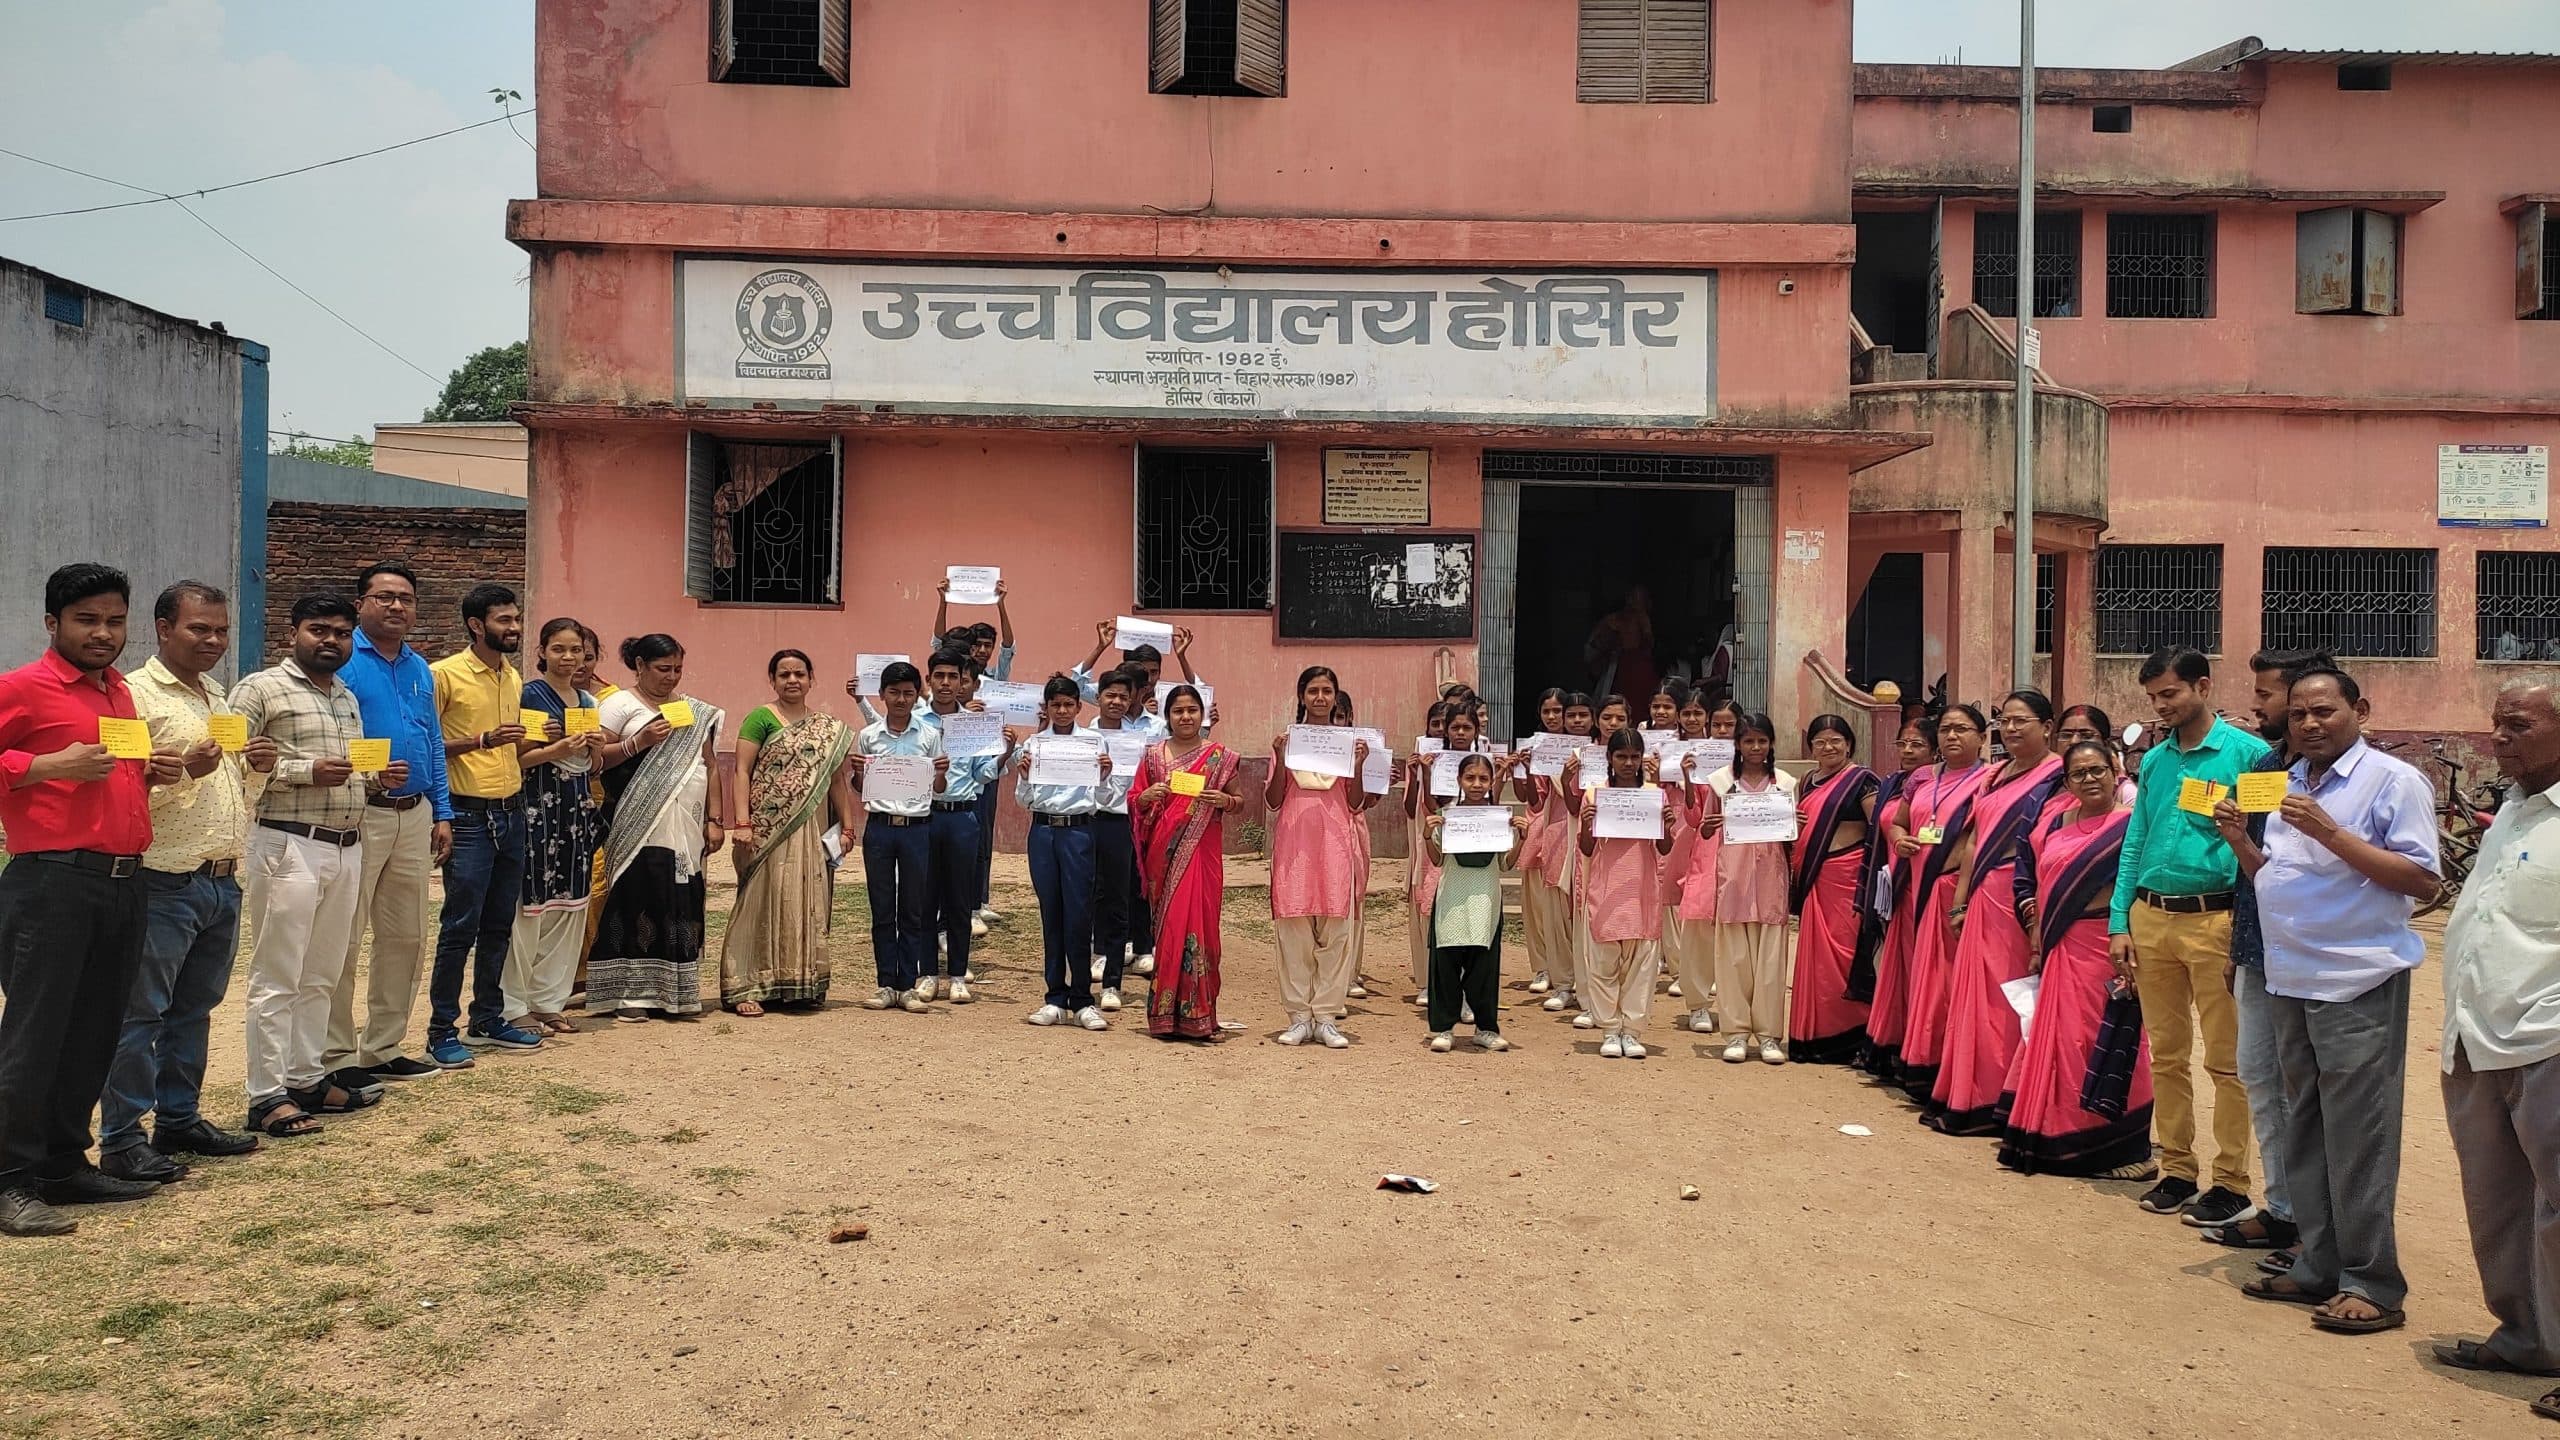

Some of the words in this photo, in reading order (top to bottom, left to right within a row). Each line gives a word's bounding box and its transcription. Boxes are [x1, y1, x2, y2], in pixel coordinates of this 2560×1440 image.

[862, 282, 1060, 341] उच्च
[1069, 272, 1438, 346] विद्यालय
[1445, 277, 1685, 351] होसिर
[1219, 352, 1265, 366] 1982
[1093, 370, 1144, 385] स्थापना
[1146, 367, 1190, 388] अनुमति
[1272, 373, 1316, 388] सरकार
[1317, 370, 1358, 388] (1987)
[1165, 387, 1203, 408] होसिर
[1616, 458, 1671, 474] HOSIR
